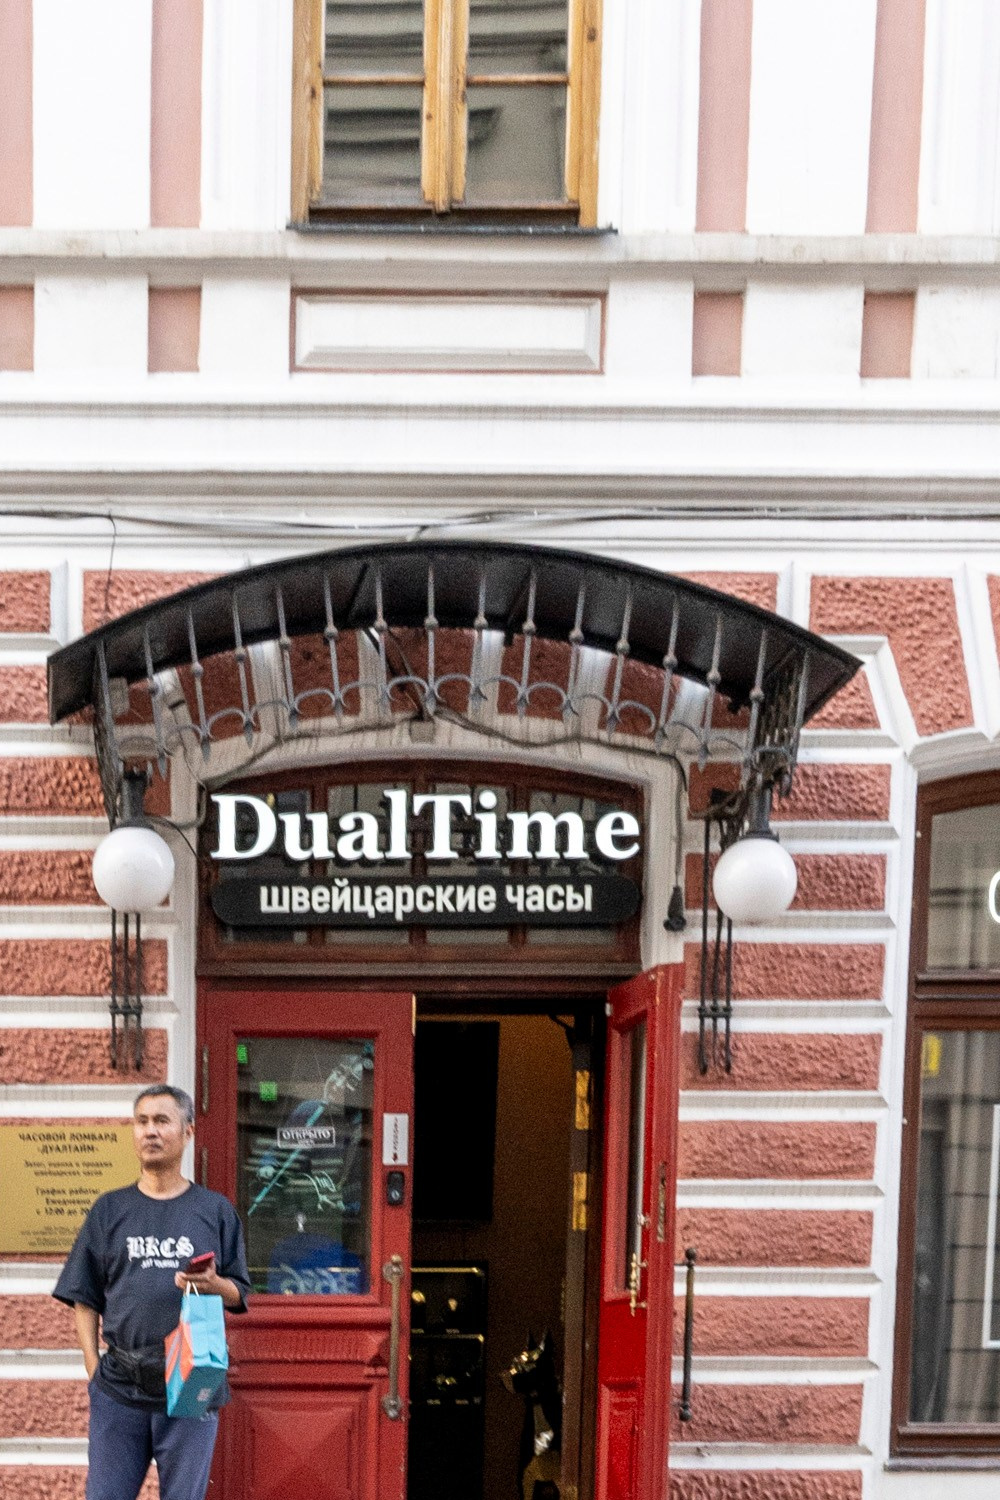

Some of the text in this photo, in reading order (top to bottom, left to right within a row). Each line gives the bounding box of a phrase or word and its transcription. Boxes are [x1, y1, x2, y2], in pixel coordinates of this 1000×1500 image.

[210, 790, 641, 861] DualTime
[259, 877, 593, 921] швейцарские часы
[18, 1132, 118, 1143] ЧАСОВОЙ ЛОМБАРД
